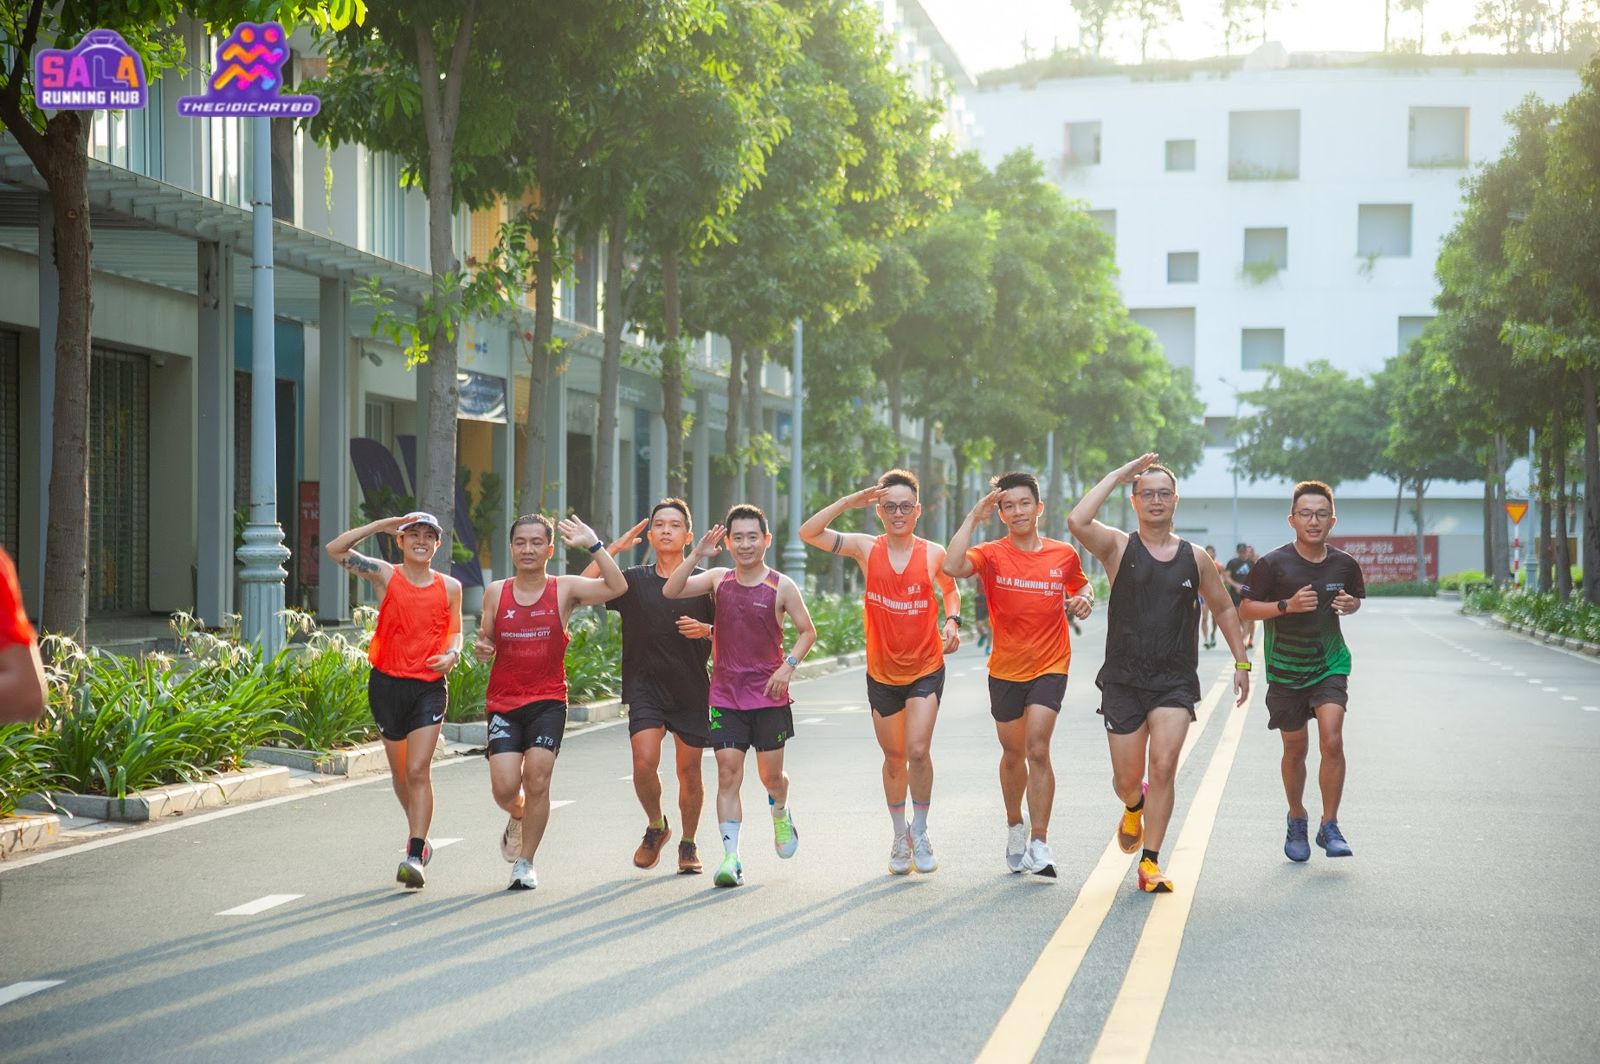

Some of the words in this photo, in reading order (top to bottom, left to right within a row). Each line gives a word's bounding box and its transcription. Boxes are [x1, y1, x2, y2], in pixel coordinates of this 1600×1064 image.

[1014, 578, 1049, 590] RUNNING
[882, 596, 913, 610] RUNNING
[914, 600, 928, 609] HUB
